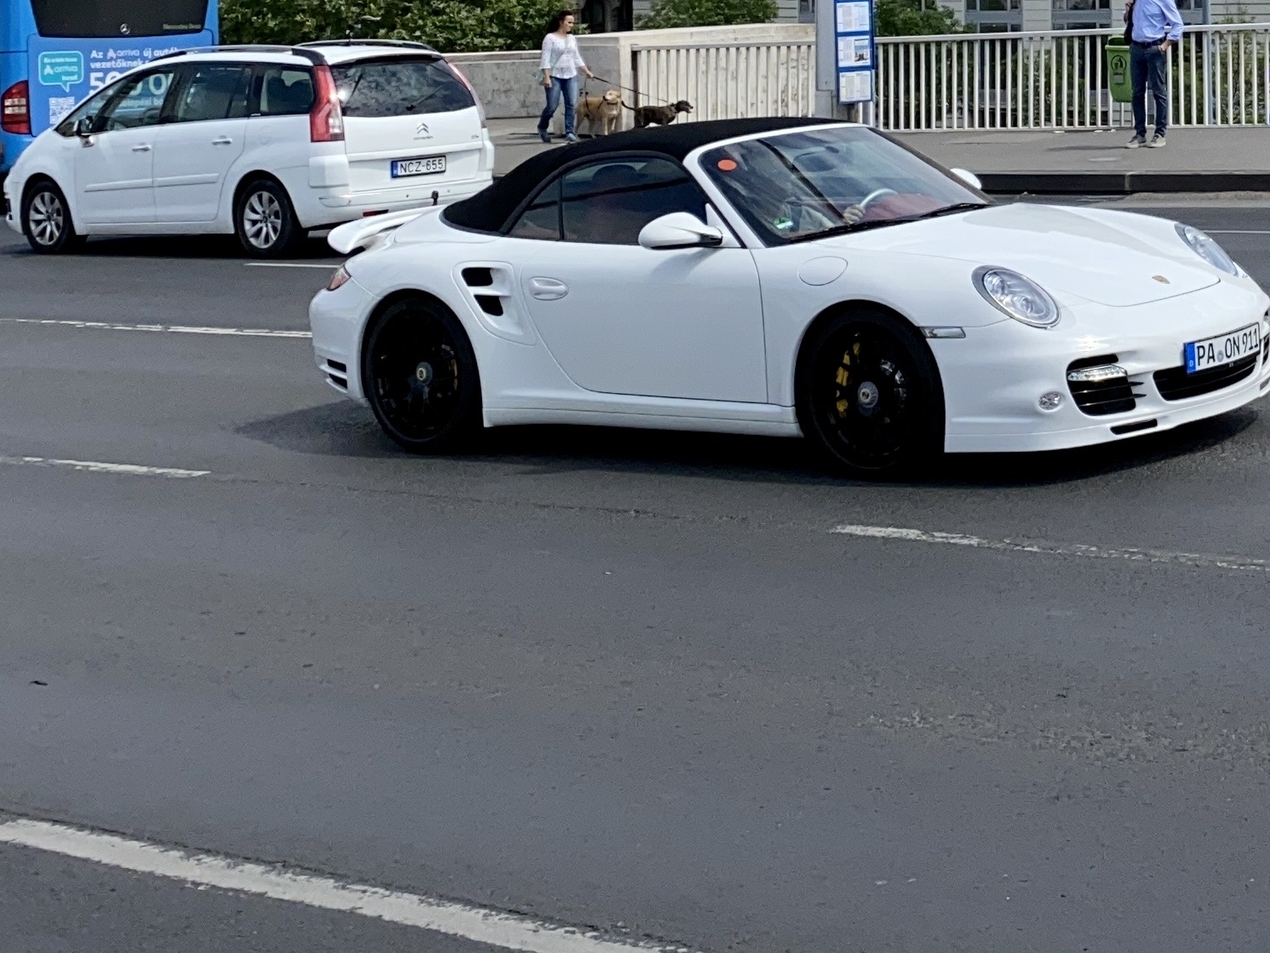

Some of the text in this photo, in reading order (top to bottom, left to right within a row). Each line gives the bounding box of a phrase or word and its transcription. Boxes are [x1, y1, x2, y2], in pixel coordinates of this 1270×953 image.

[90, 50, 104, 59] Az
[400, 159, 443, 173] NCZ-655
[1197, 328, 1259, 367] PA ON 911
